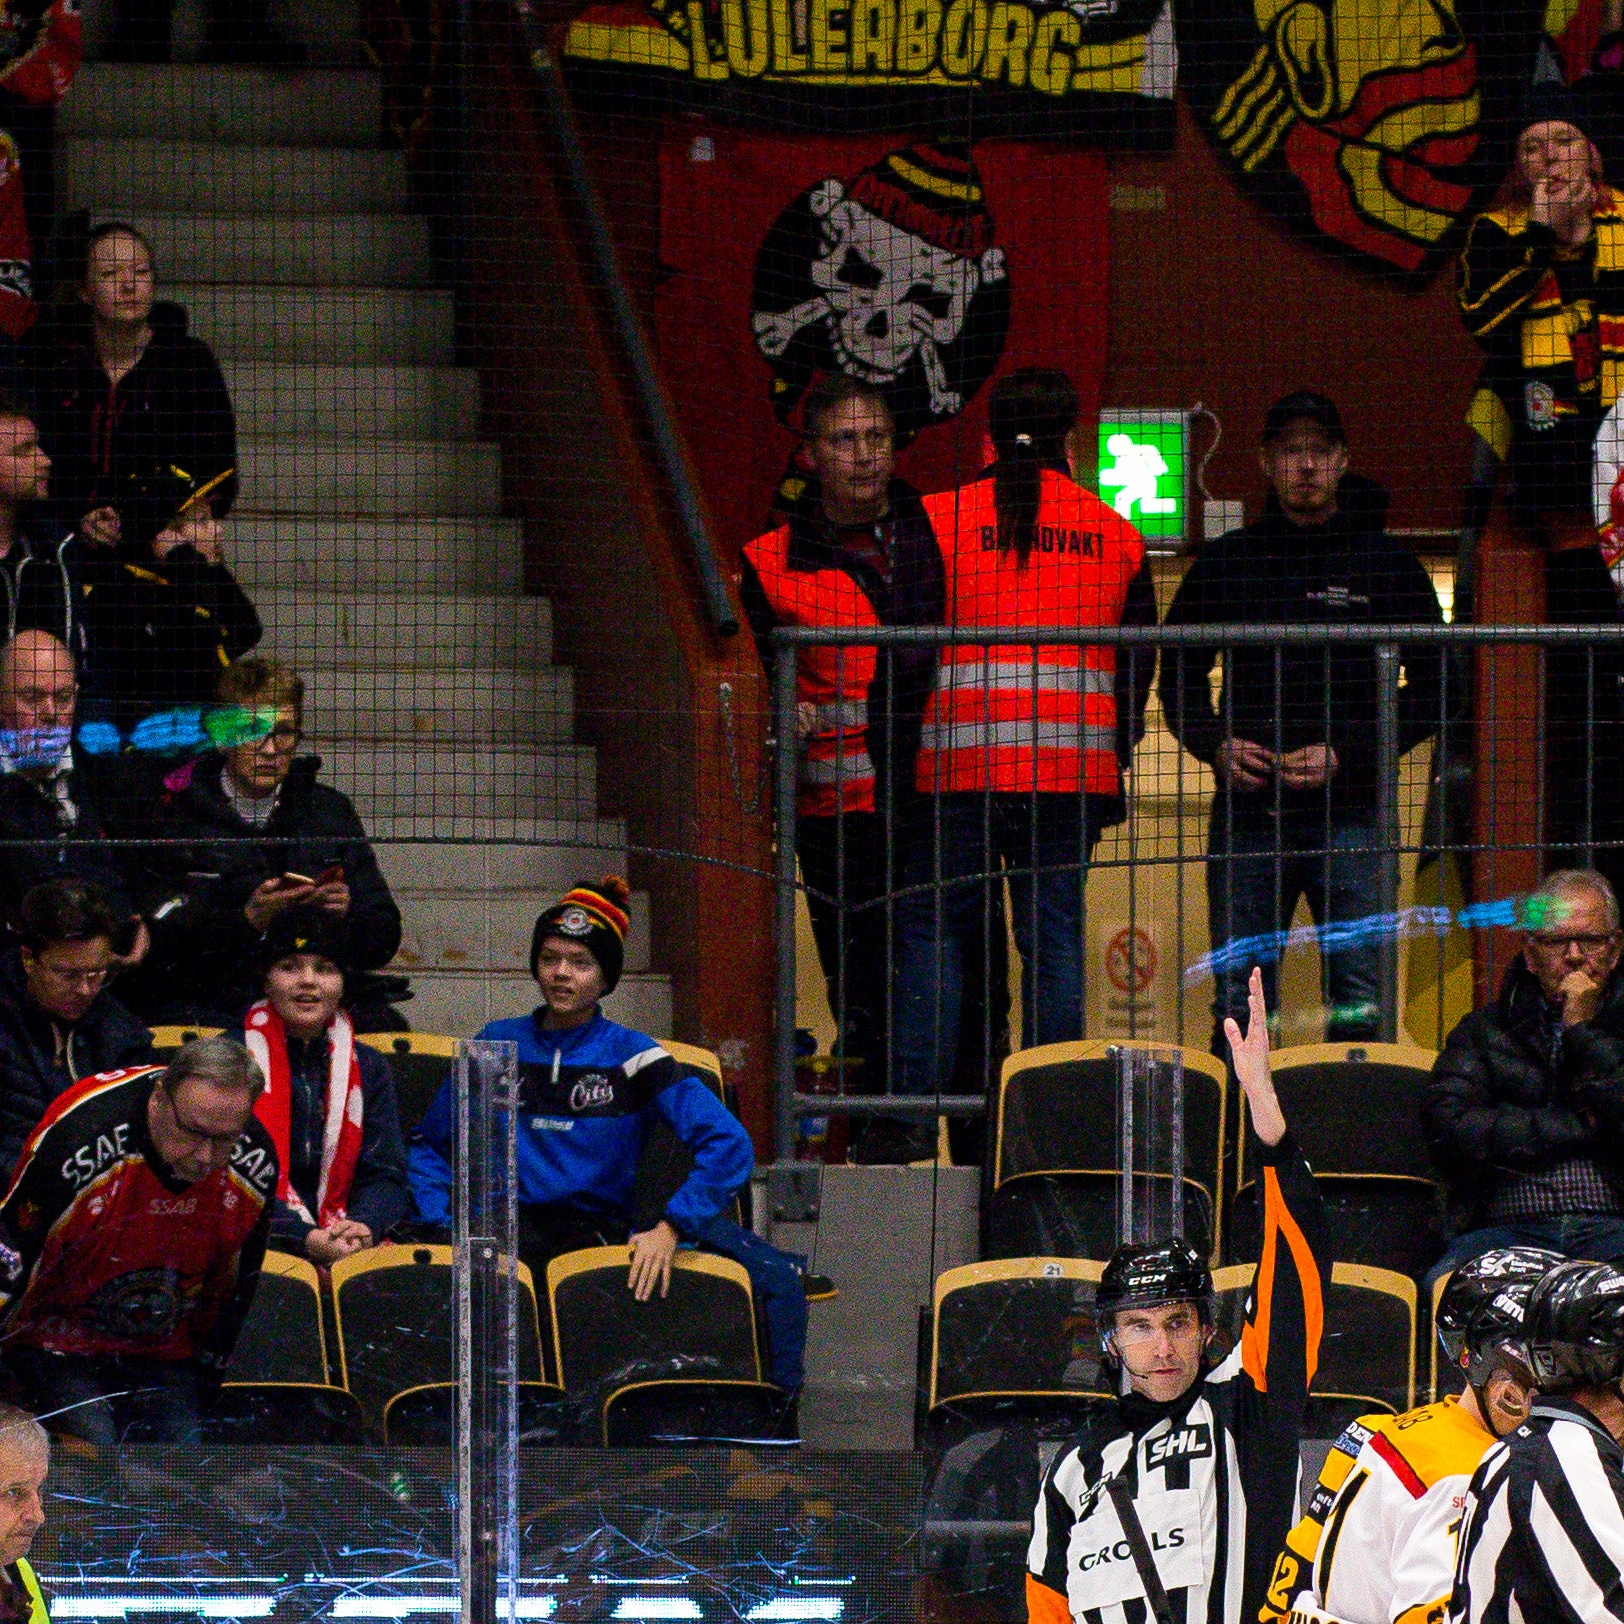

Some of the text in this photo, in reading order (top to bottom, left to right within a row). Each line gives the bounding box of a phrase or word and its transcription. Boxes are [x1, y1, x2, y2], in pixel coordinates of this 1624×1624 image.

[1128, 1274, 1167, 1286] CCM
[1149, 1429, 1207, 1464] SHL
[1078, 1527, 1186, 1573] GROLS
